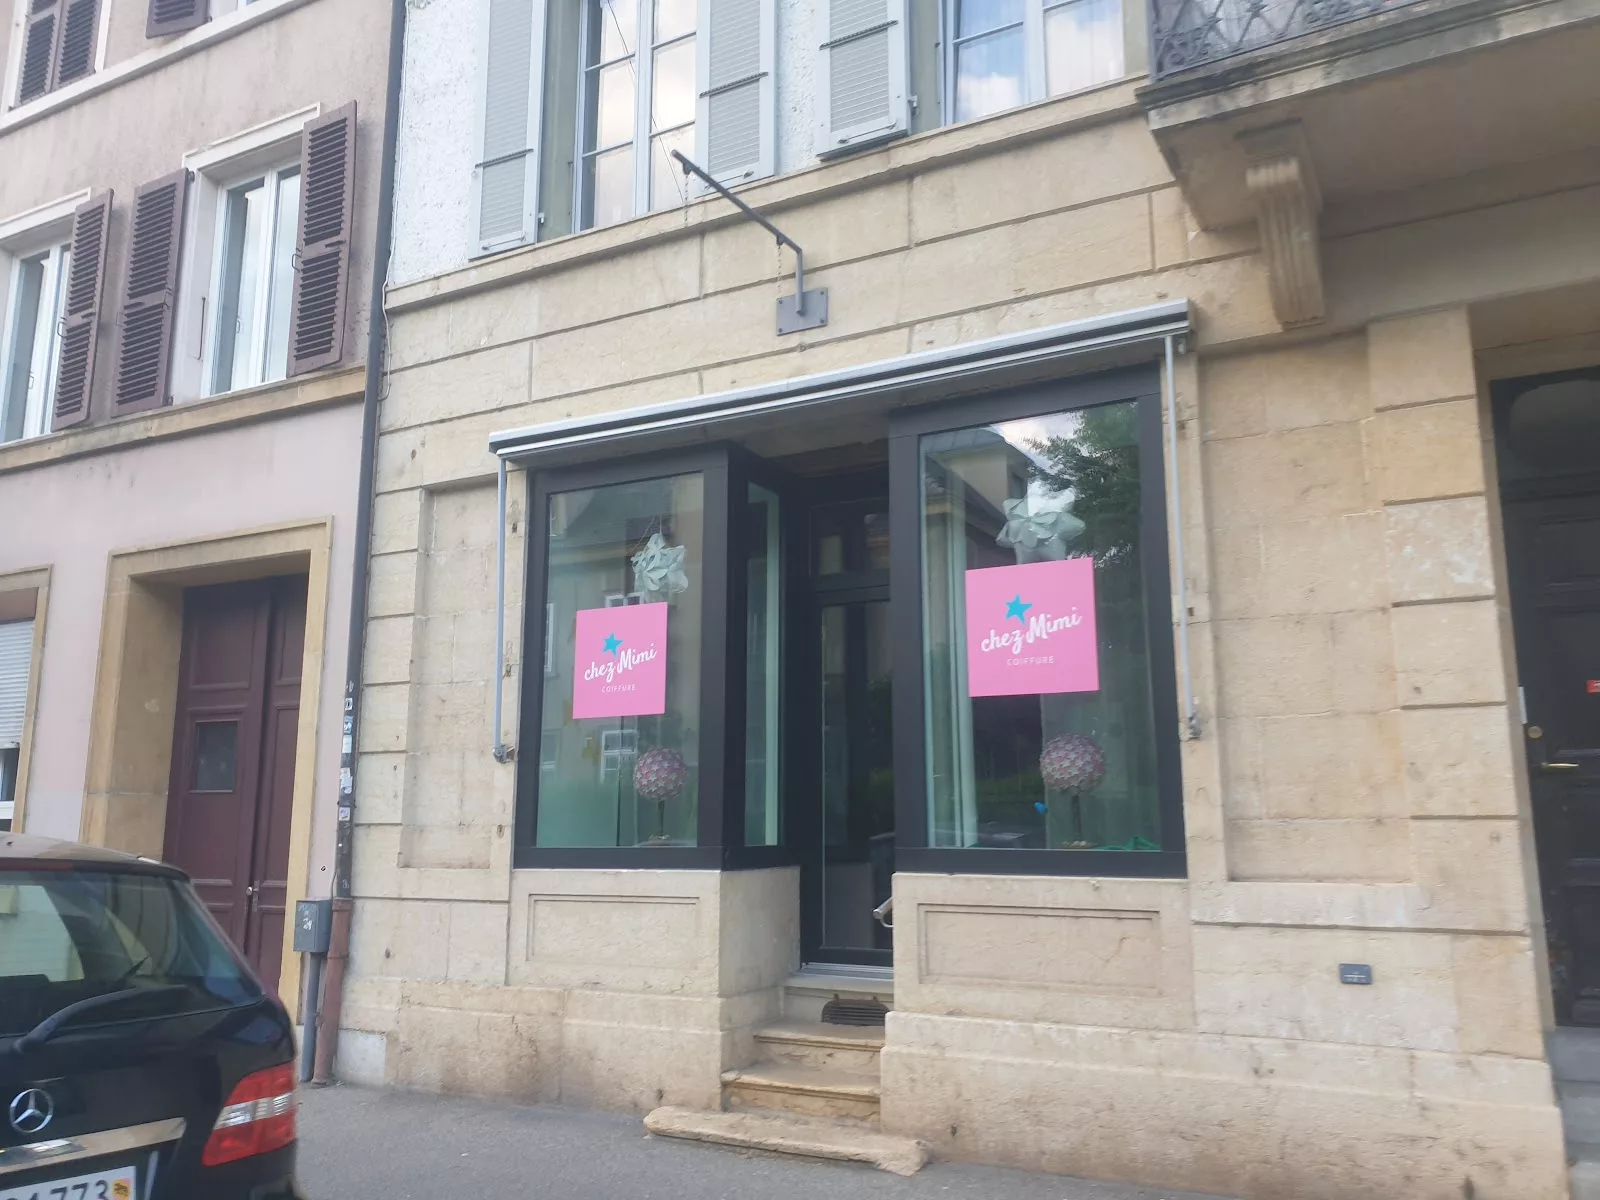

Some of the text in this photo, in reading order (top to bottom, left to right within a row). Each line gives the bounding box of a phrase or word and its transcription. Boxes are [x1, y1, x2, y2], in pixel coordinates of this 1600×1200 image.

[981, 606, 1082, 654] chez Mimi
[584, 643, 658, 683] chez Mimi
[1006, 656, 1055, 666] COIFFURE
[601, 684, 637, 693] COIFFURE
